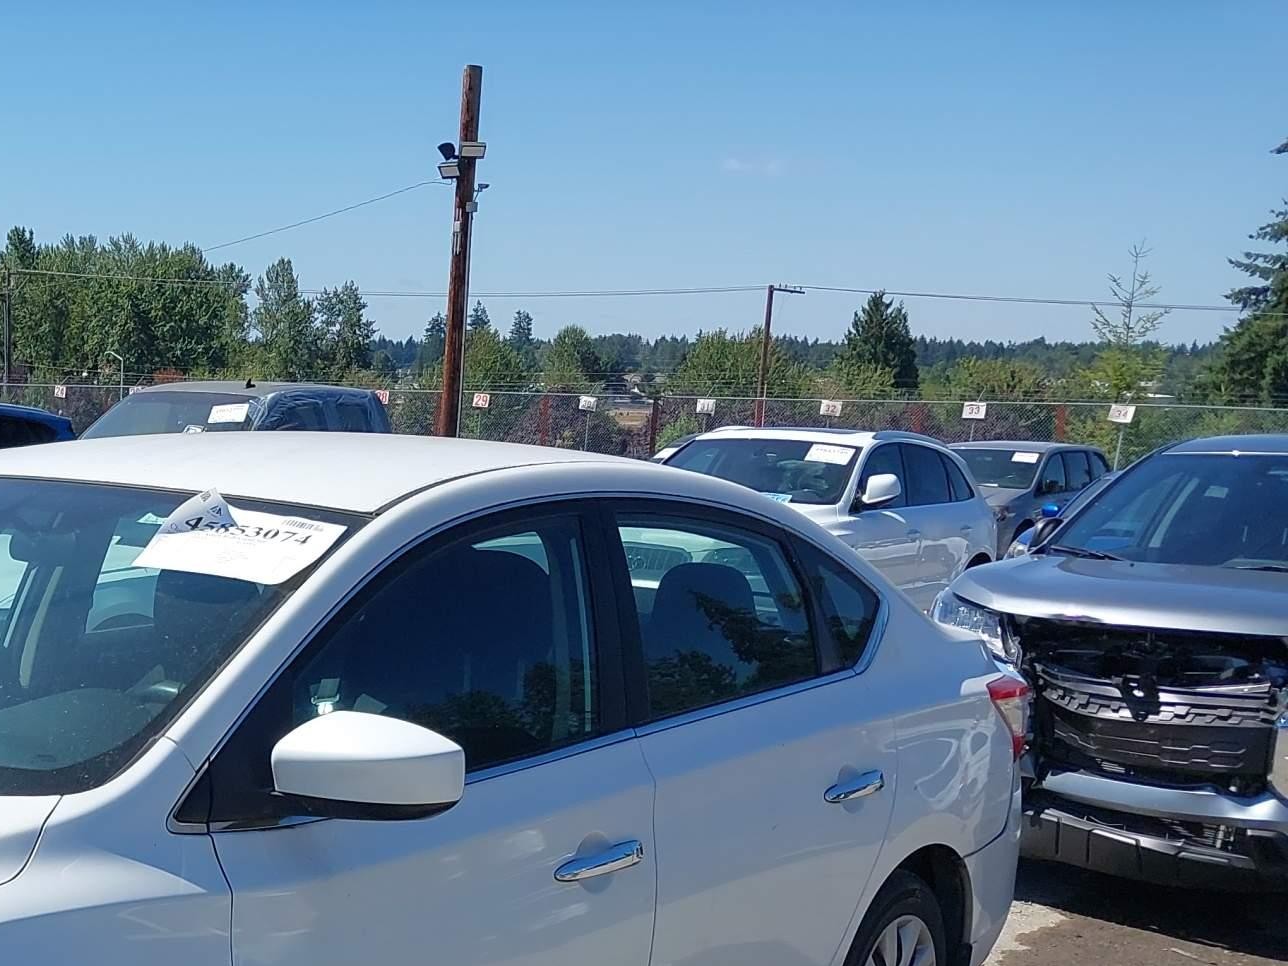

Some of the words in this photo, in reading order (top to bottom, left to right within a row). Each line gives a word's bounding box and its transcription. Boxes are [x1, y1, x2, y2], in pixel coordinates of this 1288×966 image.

[55, 386, 65, 397] 24
[475, 394, 488, 407] 29
[825, 404, 837, 413] 32
[968, 405, 980, 414] 33
[184, 515, 313, 545] 45853074
